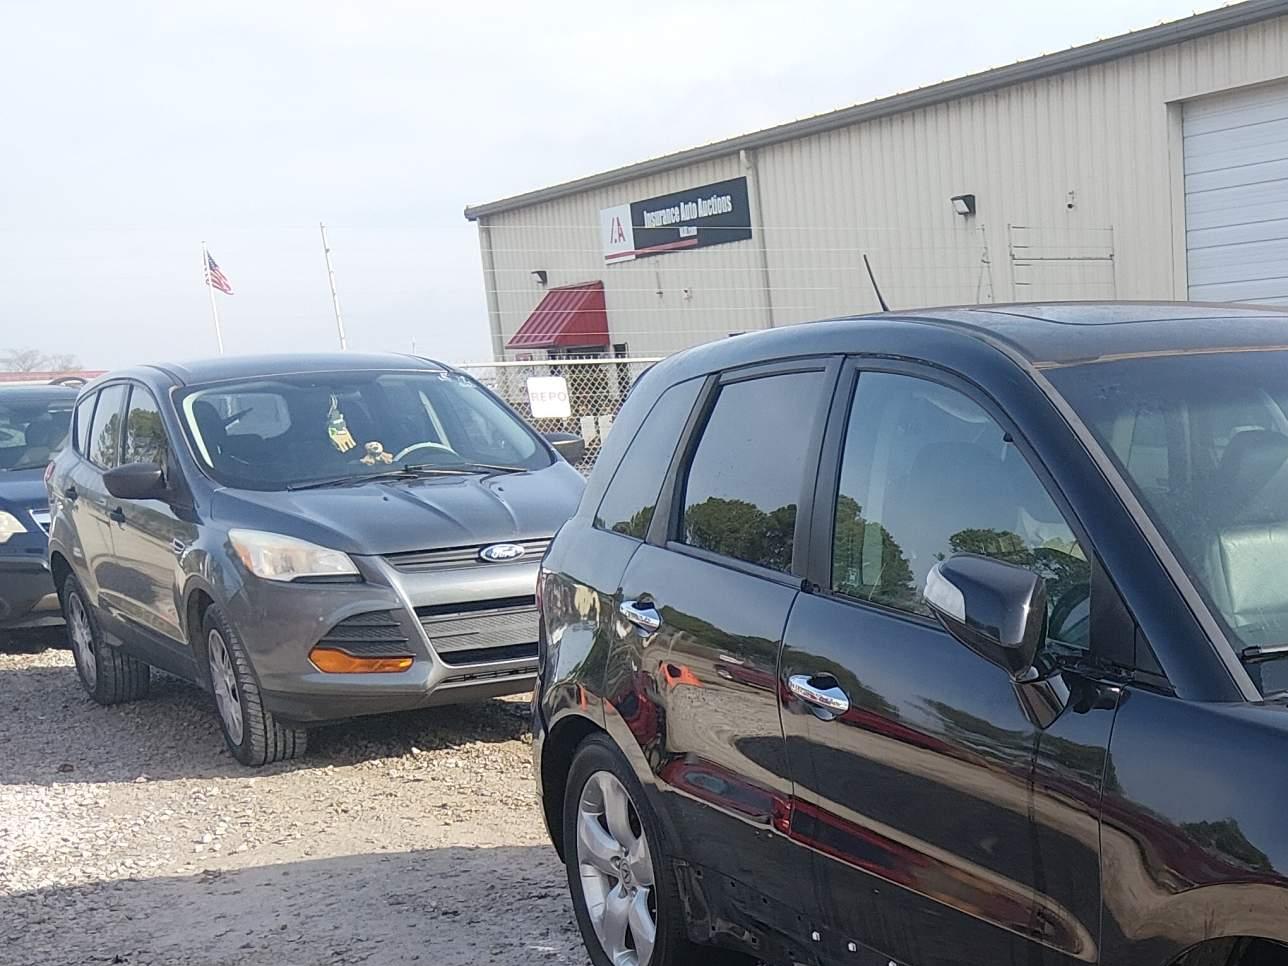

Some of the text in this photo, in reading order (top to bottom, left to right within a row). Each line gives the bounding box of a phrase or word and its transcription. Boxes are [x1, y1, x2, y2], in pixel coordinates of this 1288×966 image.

[644, 195, 732, 228] Insurance Auto Auctions
[531, 391, 566, 402] REPO
